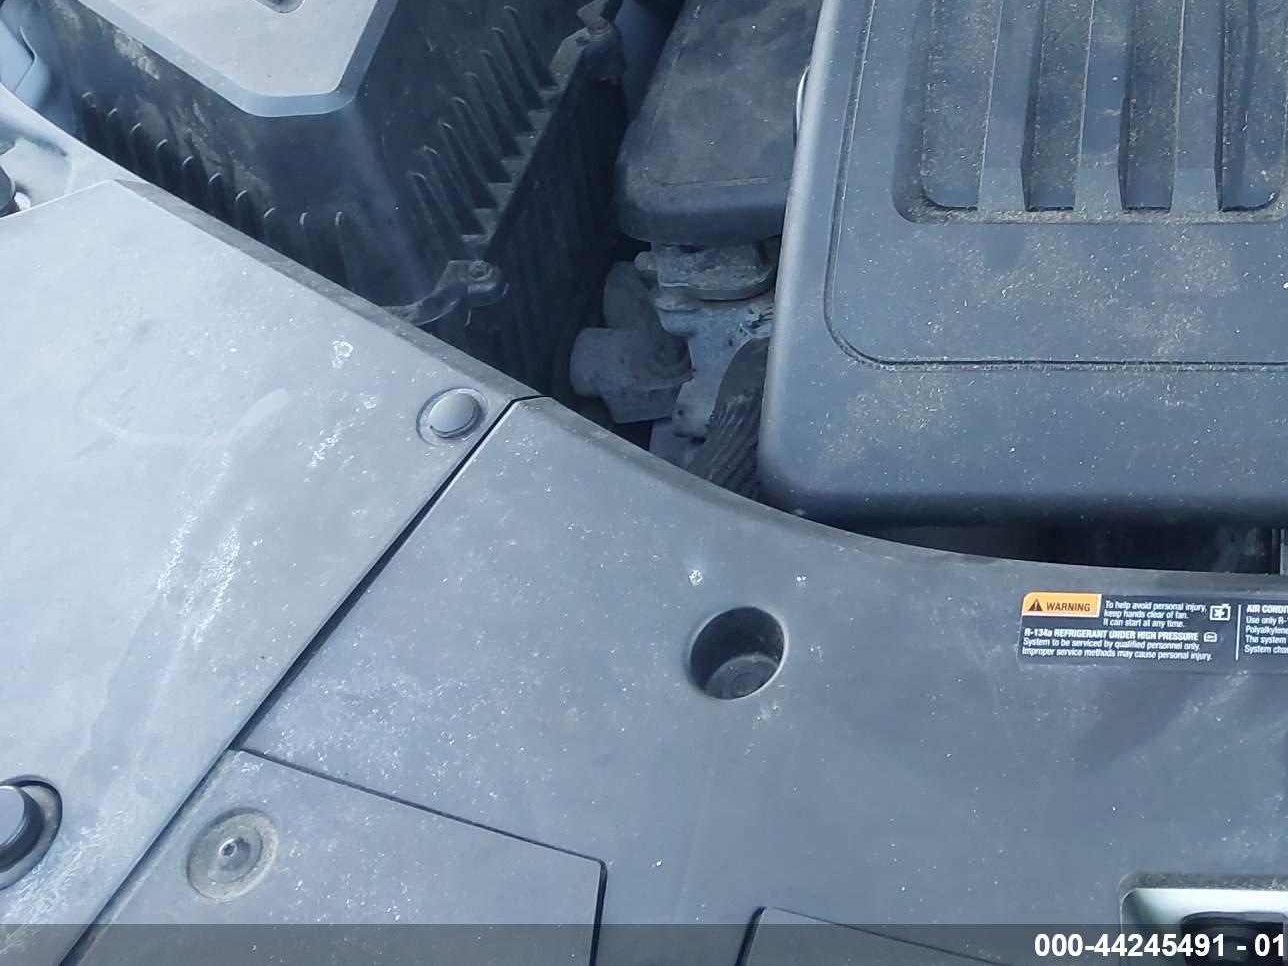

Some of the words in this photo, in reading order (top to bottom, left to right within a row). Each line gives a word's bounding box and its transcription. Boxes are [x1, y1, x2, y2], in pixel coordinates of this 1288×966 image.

[1047, 602, 1090, 612] WARNING
[1115, 601, 1130, 610] help
[1153, 603, 1184, 611] personal
[1186, 604, 1207, 612] injury,
[1247, 605, 1260, 613] AIR
[1104, 610, 1121, 618] keep
[1246, 616, 1259, 624] Use
[1261, 617, 1277, 625] only
[1024, 628, 1052, 636] R-134a
[1054, 629, 1108, 638] REFRIGERANT
[1109, 630, 1135, 639] UNDER
[1137, 631, 1156, 639] HIGH
[1158, 632, 1199, 641] PRESSURE
[1246, 625, 1288, 635] Polyalkylene
[1023, 637, 1050, 646] System
[1072, 639, 1103, 647] serviced
[1115, 641, 1145, 649] qualified
[1147, 642, 1182, 650] personnel
[1245, 635, 1259, 643] The
[1260, 636, 1286, 645] system
[1022, 647, 1055, 656] Improper
[1057, 648, 1082, 656] service
[1084, 649, 1115, 657] methods
[1118, 651, 1133, 659] may
[1158, 652, 1189, 660] personal
[1191, 652, 1213, 661] injury.
[1245, 645, 1271, 654] System
